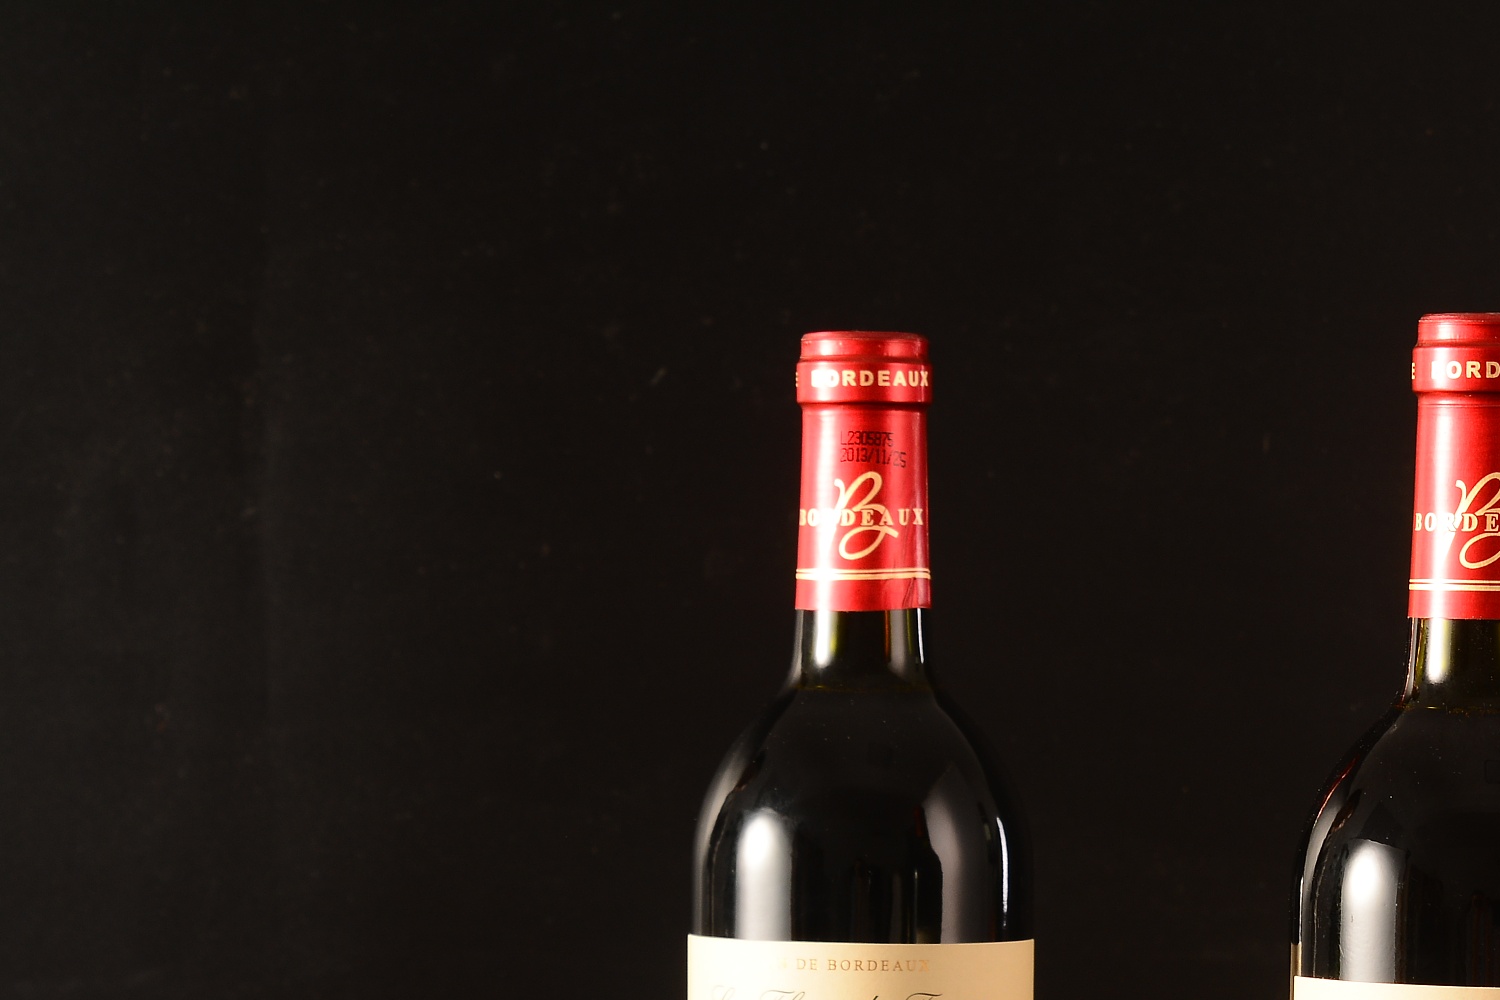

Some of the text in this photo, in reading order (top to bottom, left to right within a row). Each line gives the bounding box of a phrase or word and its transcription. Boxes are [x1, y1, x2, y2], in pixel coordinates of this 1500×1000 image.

[799, 508, 924, 527] BODEAUX
[796, 958, 819, 971] DE
[827, 958, 930, 972] BORDEAUX
